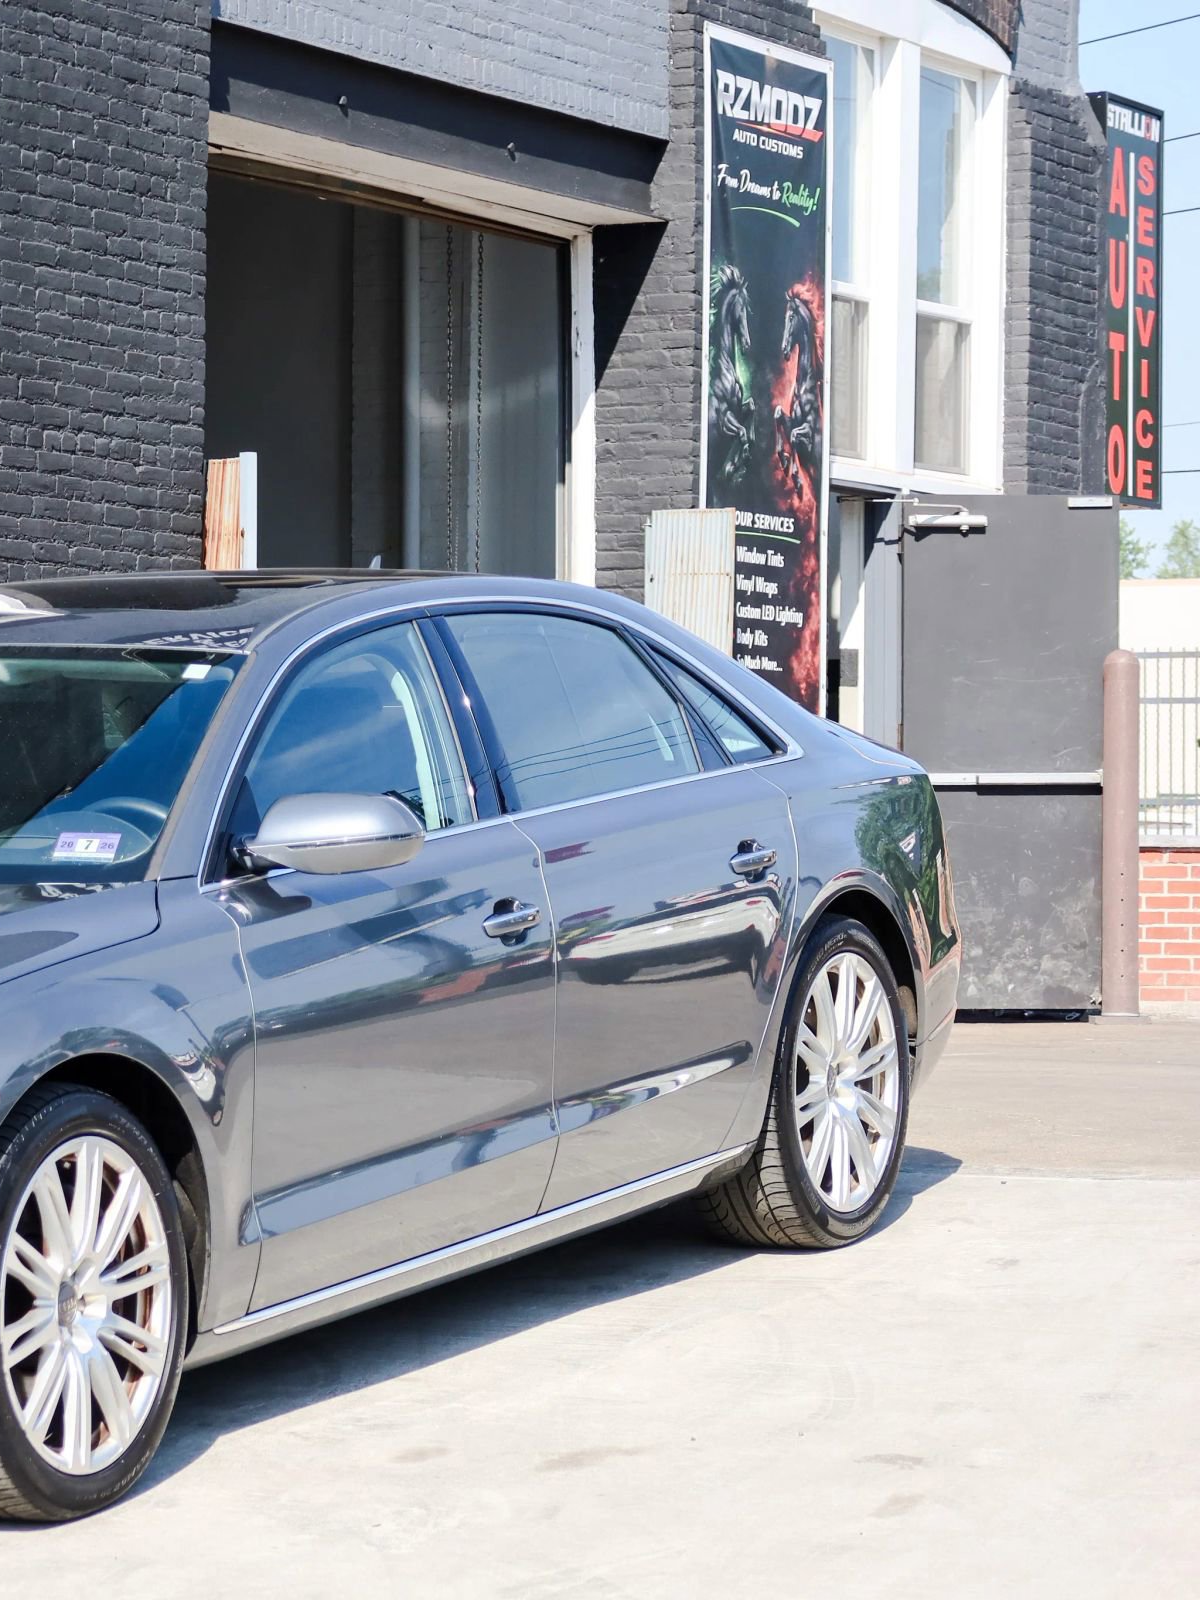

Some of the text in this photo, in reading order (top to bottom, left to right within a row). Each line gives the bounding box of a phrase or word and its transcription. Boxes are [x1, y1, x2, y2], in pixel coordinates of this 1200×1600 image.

[716, 69, 823, 135] RZMODZ
[1107, 103, 1160, 142] STALLION
[733, 128, 804, 159] AUTO CUSTOMS
[717, 163, 820, 216] From Dreams to Reality!
[1108, 146, 1127, 495] AUTO
[1136, 155, 1156, 500] SERVICE
[735, 510, 795, 533] OUR SERVICES
[736, 545, 785, 568] Window Tints
[736, 574, 779, 599] Vinyl Wraps
[736, 601, 804, 628] Custom LED Lighting
[736, 628, 769, 649] Body Kits
[744, 655, 761, 670] Much
[761, 656, 783, 672] More...
[84, 840, 94, 850] 7
